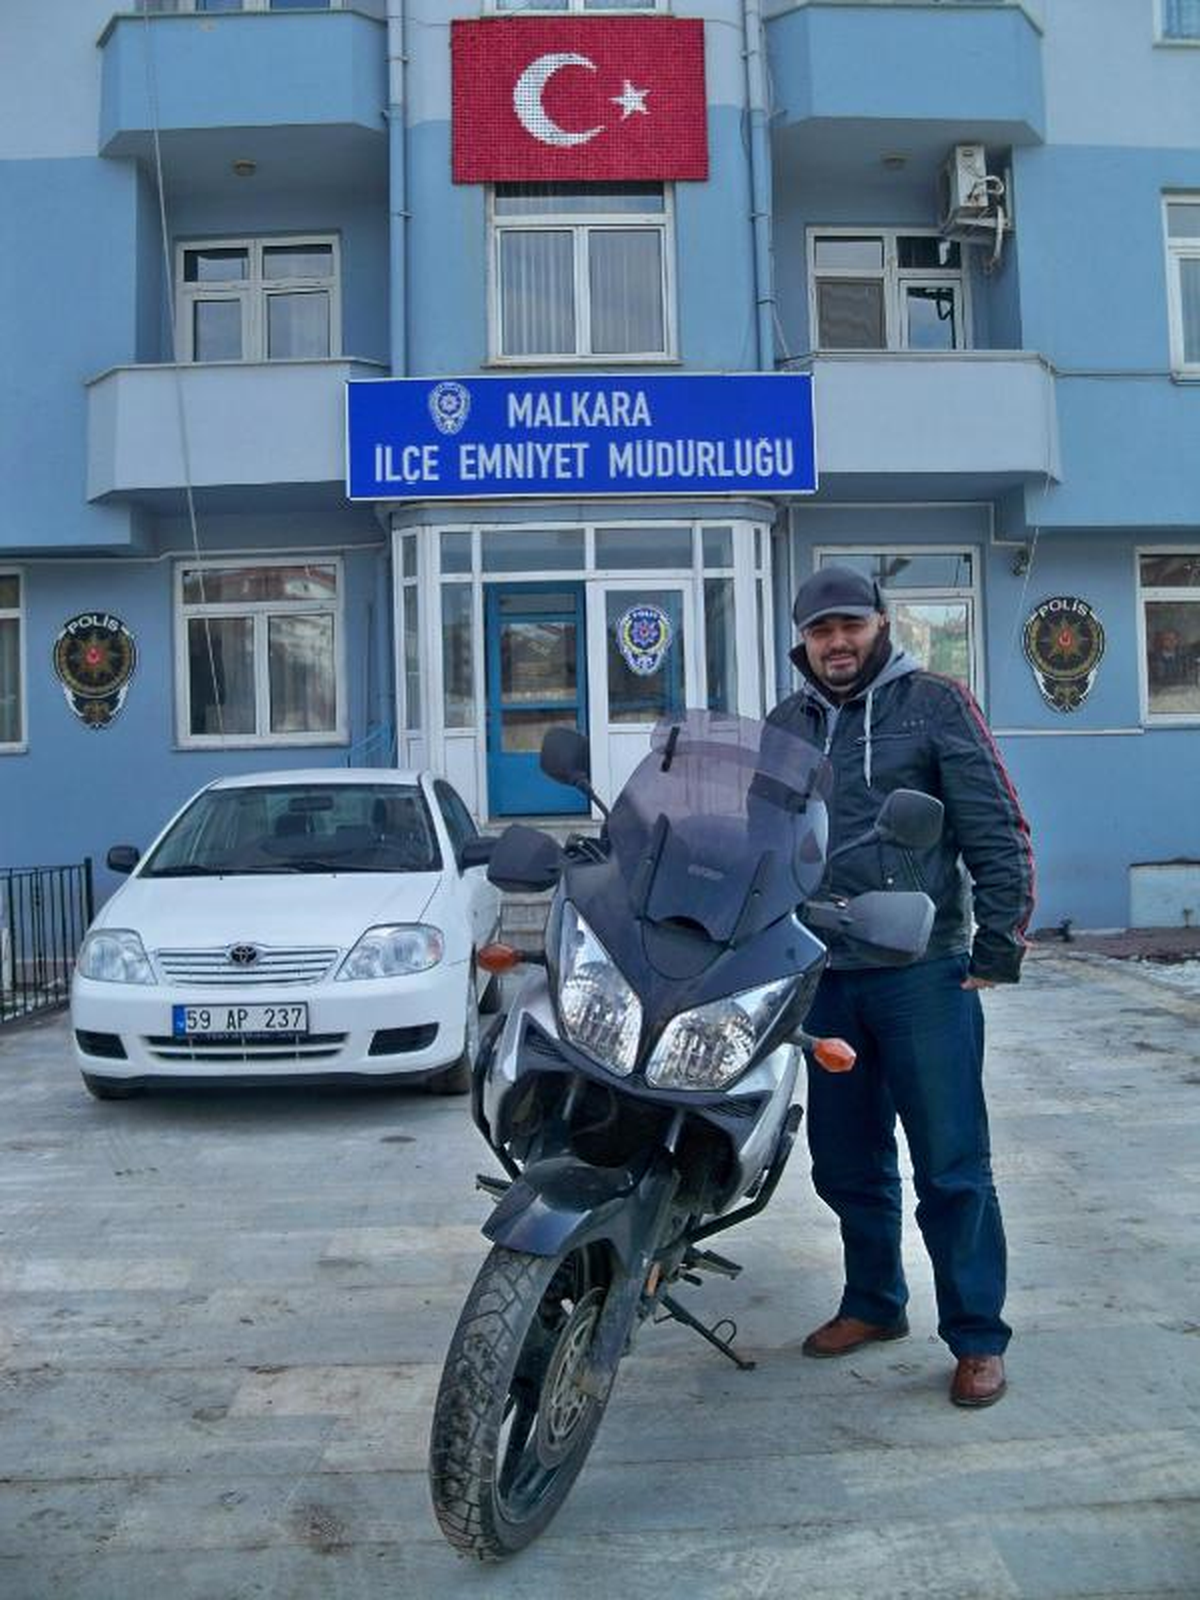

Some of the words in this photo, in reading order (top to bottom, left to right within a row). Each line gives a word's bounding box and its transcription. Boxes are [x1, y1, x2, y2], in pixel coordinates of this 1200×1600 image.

[507, 391, 652, 429] MALKARA
[459, 440, 589, 480] EMNİYET
[187, 1009, 211, 1030] 59
[226, 1008, 249, 1030] AP
[264, 1007, 302, 1029] 237
